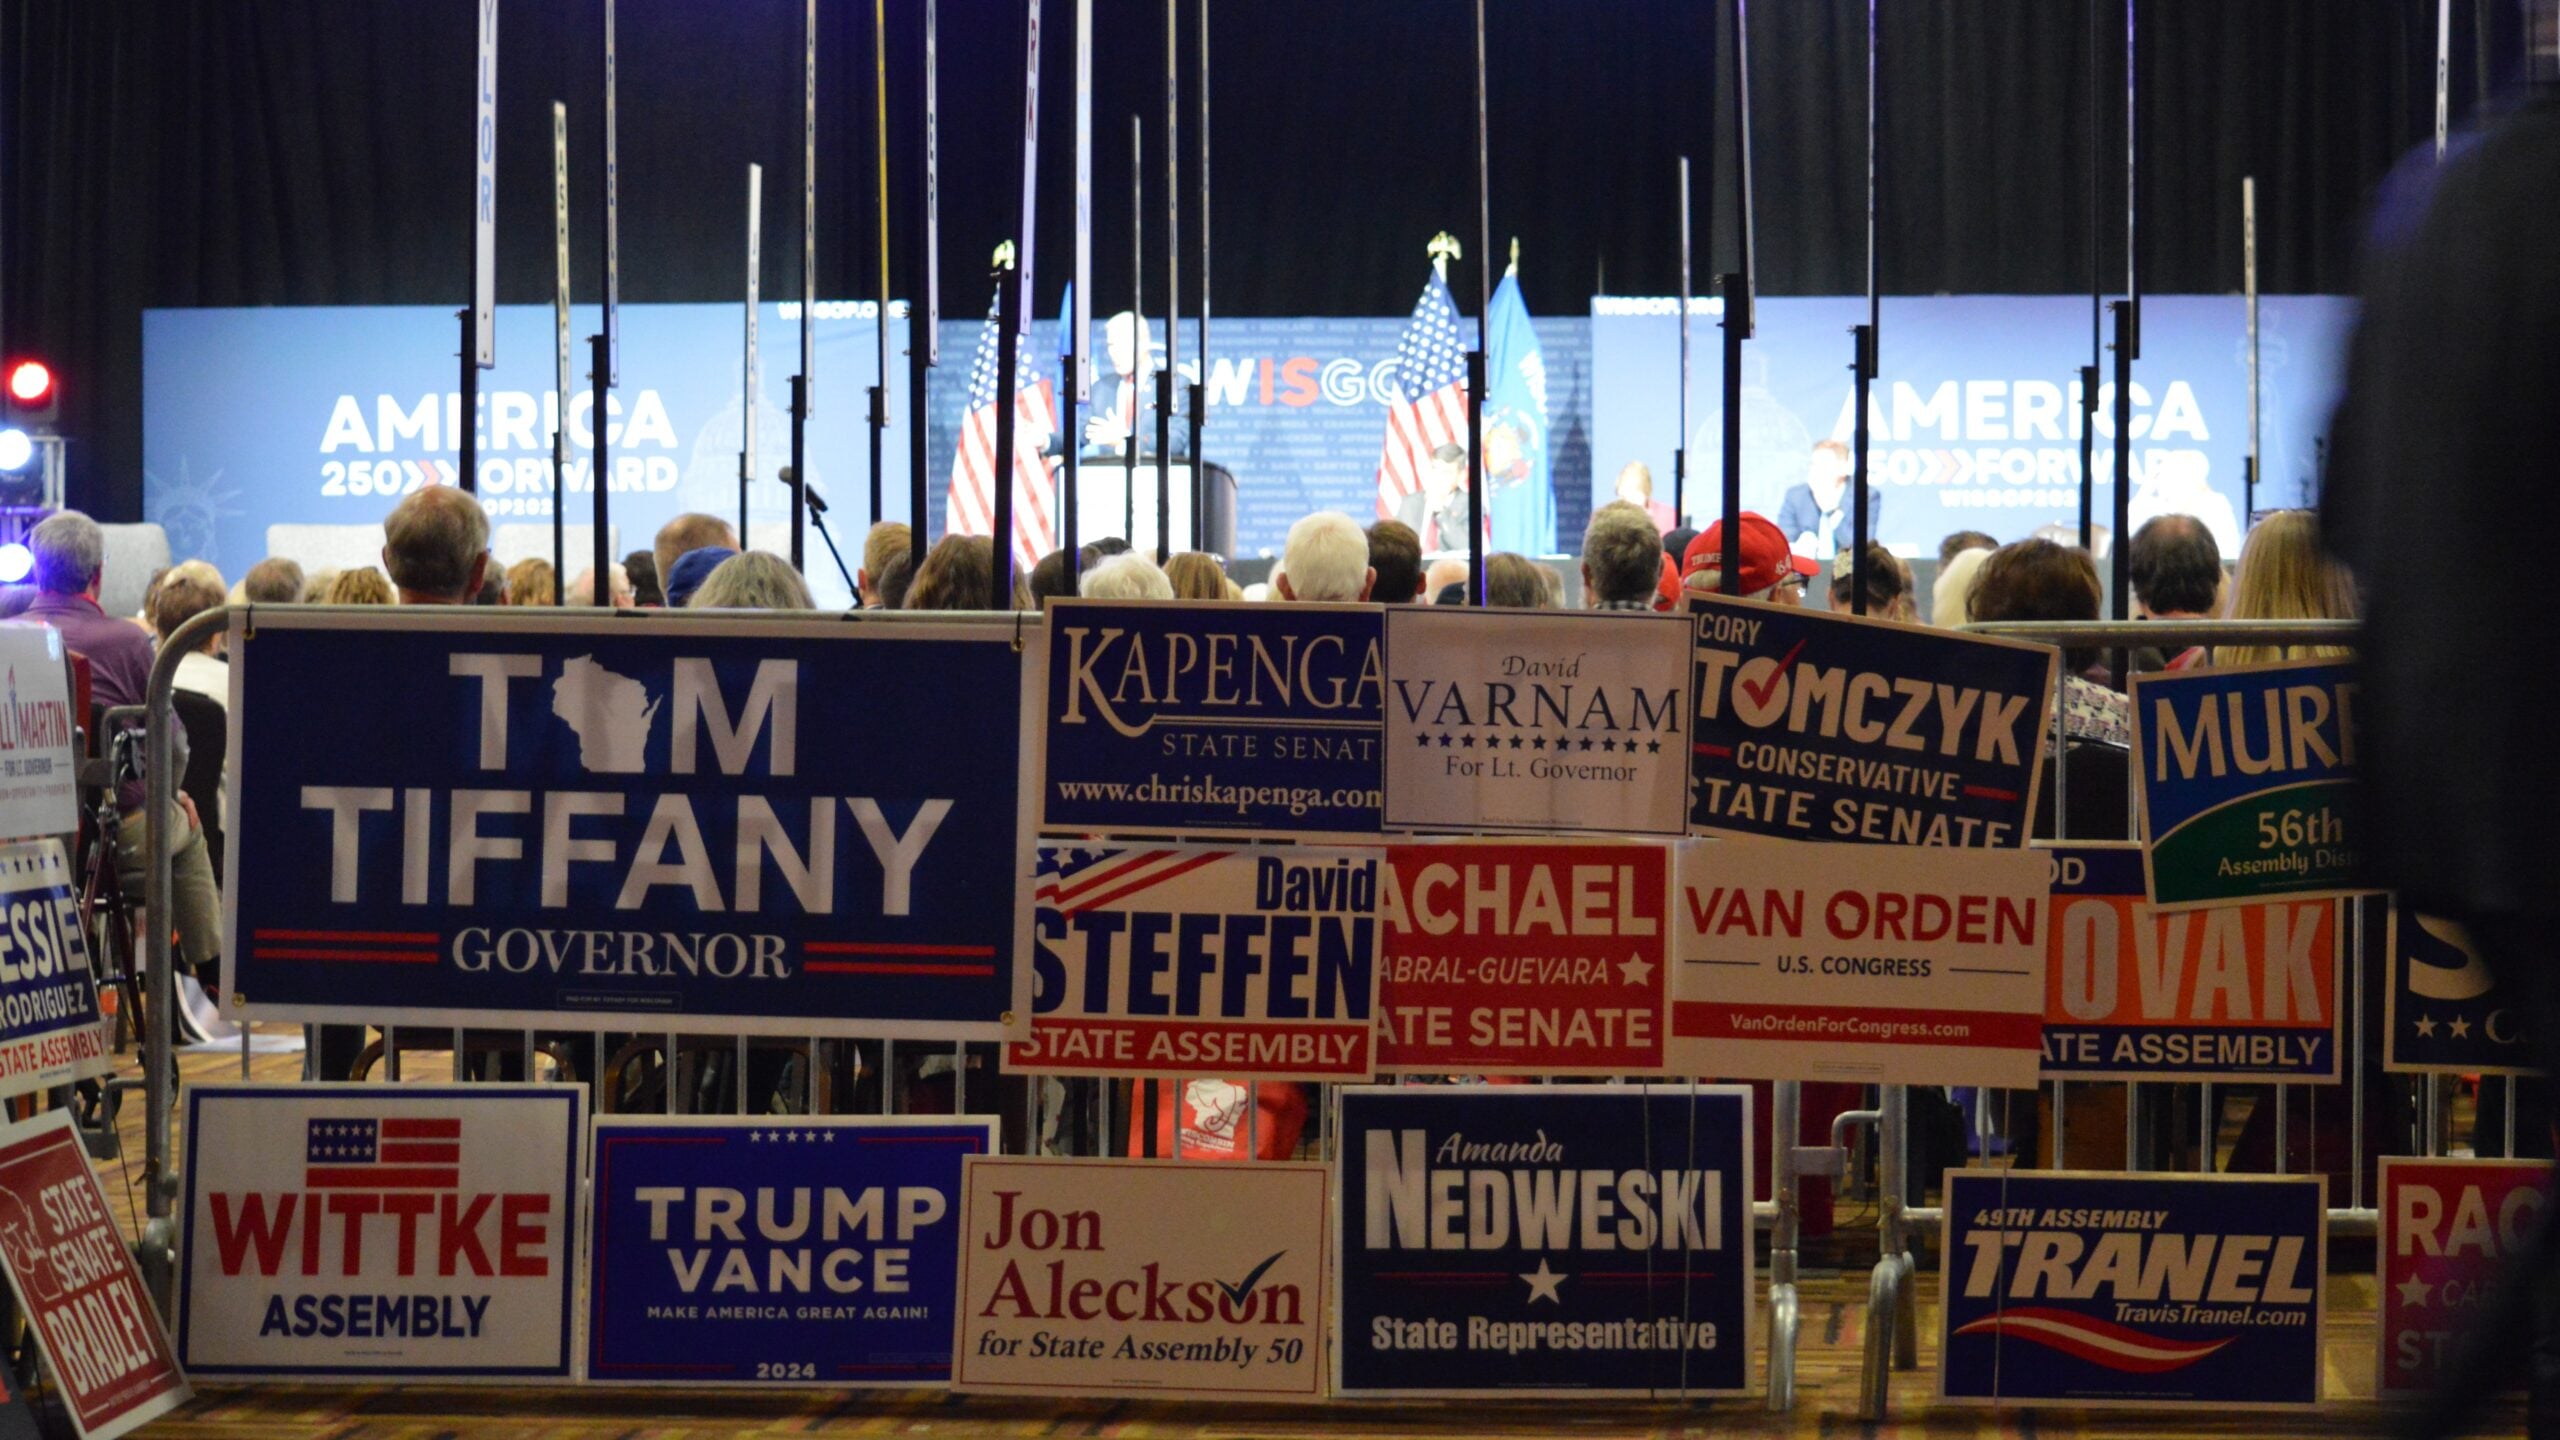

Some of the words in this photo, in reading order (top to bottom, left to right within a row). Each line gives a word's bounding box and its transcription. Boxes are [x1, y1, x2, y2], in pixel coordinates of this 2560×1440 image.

[1208, 357, 1404, 407] WISGO
[320, 390, 679, 453] AMERICA
[1831, 381, 2209, 441] AMERICA
[321, 460, 401, 496] 250
[476, 456, 679, 494] ORWARD
[1868, 448, 1919, 486] 50
[1939, 489, 2077, 508] WISGOP202
[1698, 613, 1762, 646] CORY
[1061, 625, 1384, 738] KAPENGA
[1501, 652, 1581, 677] David
[17, 700, 69, 750] MARTIN
[1392, 679, 1682, 734] VARNAM
[1695, 646, 2029, 767] TOMCZYK
[1162, 734, 1258, 758] STATE
[1274, 737, 1383, 762] SENAT
[2156, 682, 2357, 783] MUR
[1445, 756, 1487, 779] For
[1491, 757, 1524, 780] Lt.
[1530, 757, 1638, 783] Governor
[1735, 740, 1961, 802] CONSERVATIVE
[1830, 798, 2012, 848] SENATE
[2257, 806, 2343, 850] 56th
[301, 785, 954, 916] TIFFANY
[2217, 851, 2309, 878] Assembly
[1256, 856, 1378, 913] David
[1383, 862, 1657, 936] ACHAEL
[1684, 886, 1803, 939] VAN
[1824, 889, 2038, 946] ORDEN
[451, 926, 792, 982] GOVERNOR
[1032, 906, 1375, 1020] STEFFEN
[1380, 956, 1609, 985] ABRAL-GUEVARA
[1776, 954, 1814, 975] U.S.
[1819, 955, 1932, 979] CONGRESS
[2061, 900, 2326, 1022] OVAK
[40, 1028, 105, 1069] ASSEMBLY
[1020, 1025, 1136, 1061] STATE
[1145, 1030, 1360, 1066] ASSEMBLY
[1377, 1006, 1453, 1046] ATE
[1468, 1007, 1653, 1048] SENATE
[1731, 1012, 1970, 1038] VanOrdenForCongress.com
[2041, 1033, 2102, 1065] ATE
[2112, 1033, 2321, 1067] ASSEMBLY
[1434, 1130, 1563, 1165] Amanda
[39, 1175, 102, 1237] STATE
[1364, 1128, 1723, 1251] NEDWESKI
[208, 1191, 551, 1278] WITTKE
[634, 1186, 947, 1242] TRUMP
[984, 1190, 1105, 1254] Jon
[1973, 1207, 2036, 1228] 49TH
[2039, 1208, 2169, 1231] ASSEMBLY
[50, 1228, 124, 1294] SENATE
[667, 1248, 912, 1294] VANCE
[1962, 1230, 2314, 1304] TRANEL
[646, 1306, 699, 1319] MAKE
[706, 1306, 790, 1320] AMERICA
[796, 1307, 856, 1320] GREAT
[861, 1307, 928, 1320] AGAIN!
[979, 1256, 1305, 1327] Aleckson
[2114, 1302, 2307, 1326] TravisTranel.com
[44, 1277, 158, 1398] BRADLEY
[259, 1293, 491, 1339] ASSEMBLY
[1371, 1316, 1458, 1350] State
[1467, 1317, 1717, 1354] Representative
[755, 1362, 817, 1381] 2024
[976, 1330, 1023, 1359] for
[1029, 1331, 1105, 1361] State
[1112, 1333, 1259, 1368] Assembly
[1265, 1337, 1304, 1365] 50
